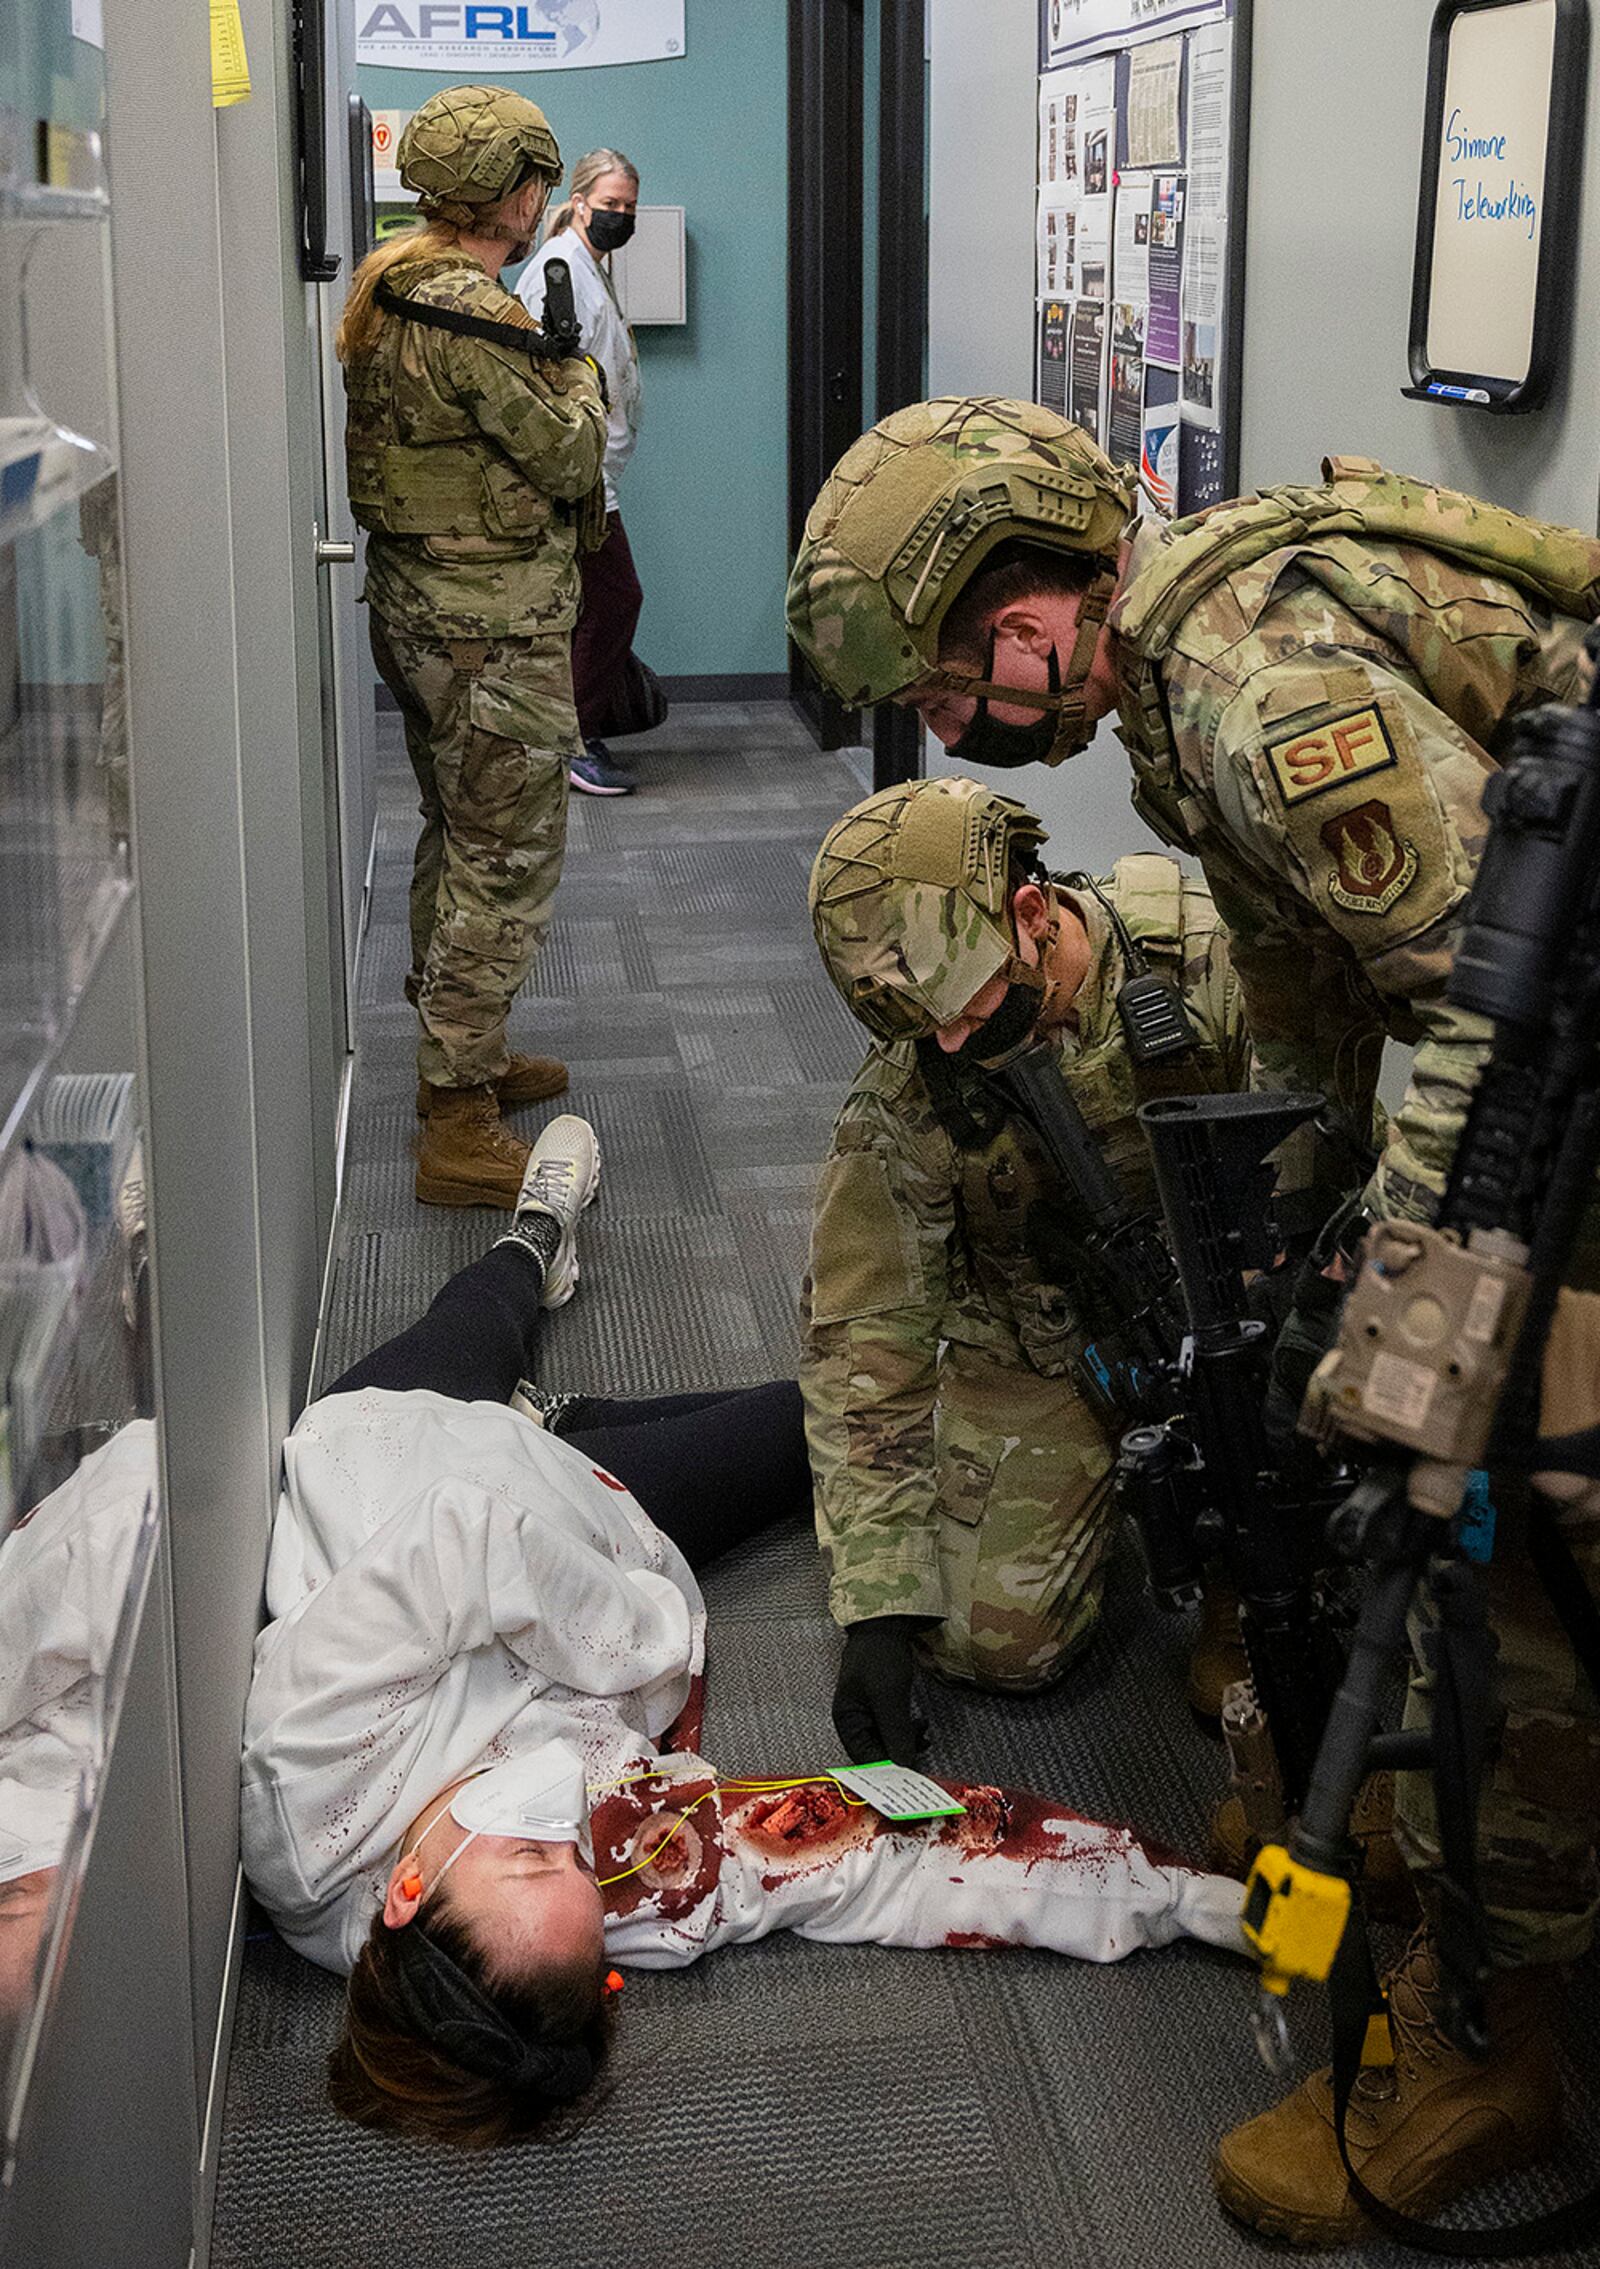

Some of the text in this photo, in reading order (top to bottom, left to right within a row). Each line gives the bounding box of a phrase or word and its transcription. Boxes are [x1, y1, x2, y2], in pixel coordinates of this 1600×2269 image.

[358, 4, 556, 39] AFRL
[1446, 108, 1506, 162] Simone
[1452, 178, 1536, 240] Teleworking
[1284, 718, 1373, 786] SF
